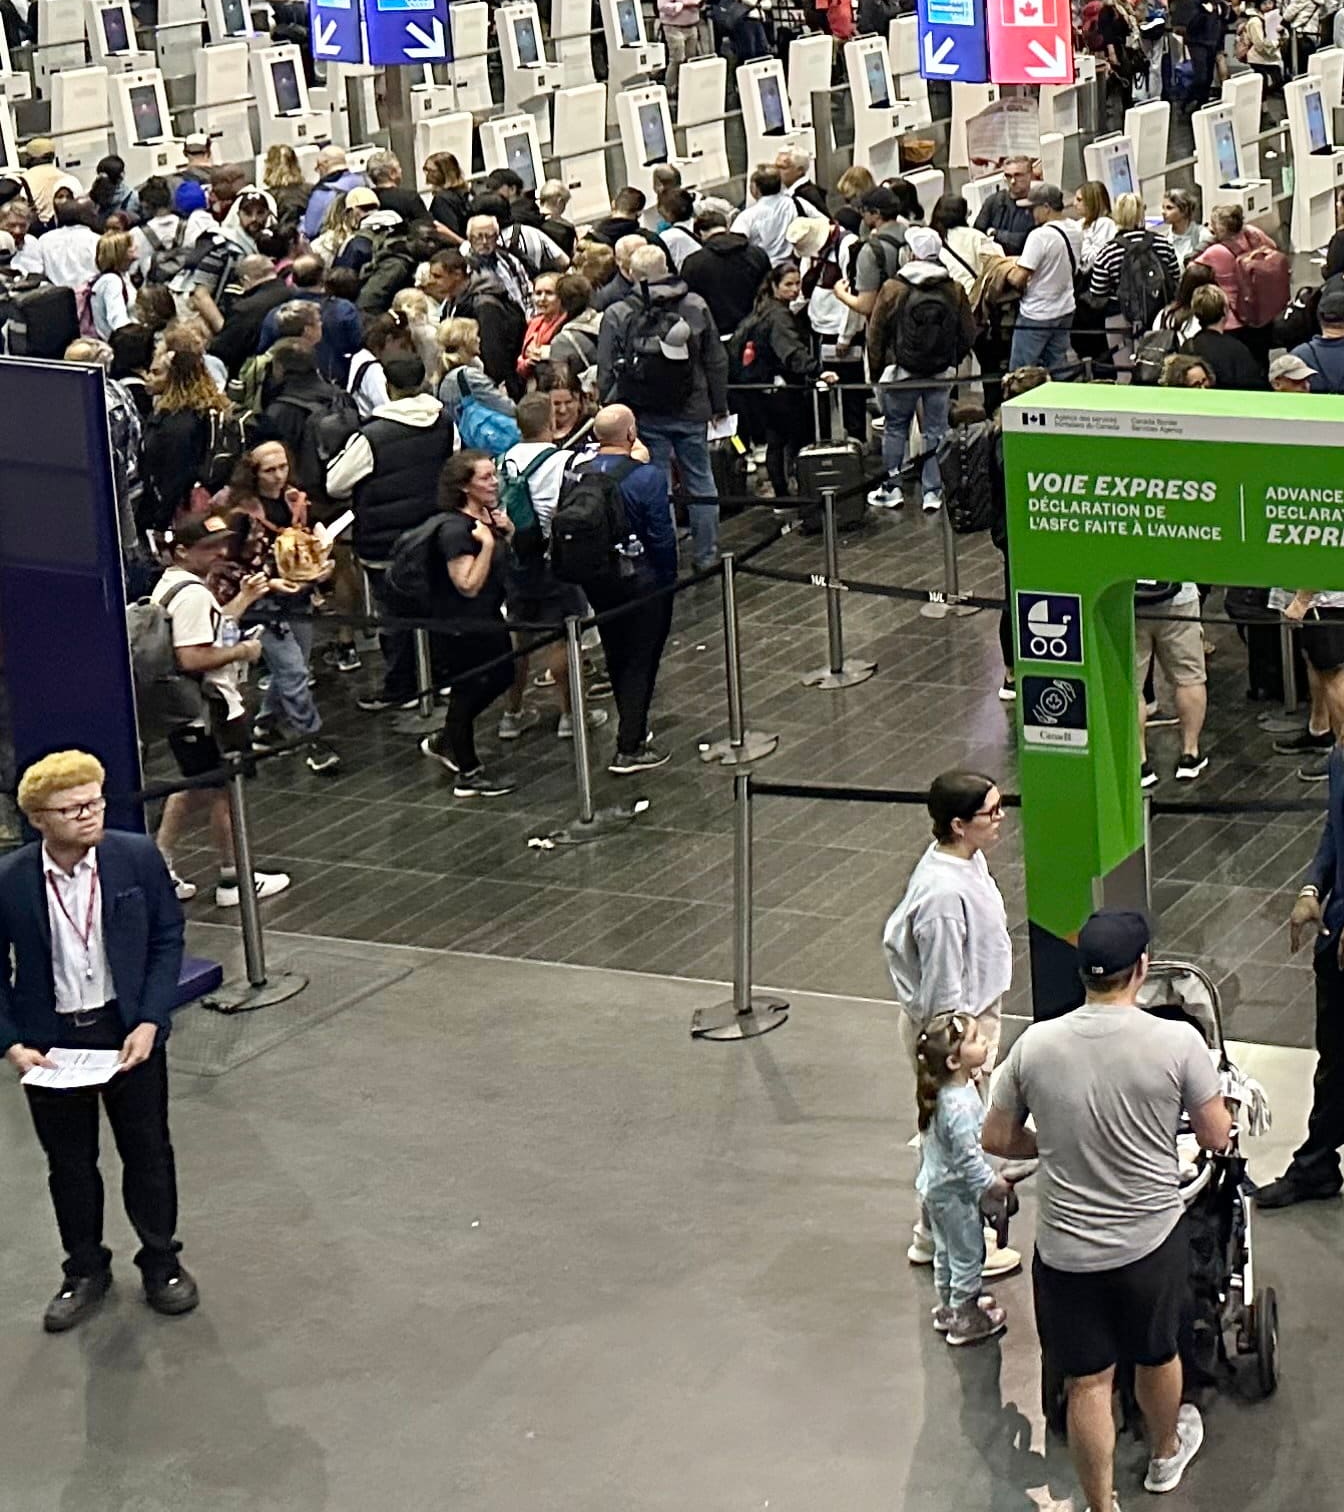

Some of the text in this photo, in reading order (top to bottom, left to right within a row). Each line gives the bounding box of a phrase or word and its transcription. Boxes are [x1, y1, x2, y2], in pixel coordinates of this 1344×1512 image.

[1027, 472, 1217, 502] VOIE EXPRESS
[1266, 486, 1344, 503] ADVANCE
[1028, 495, 1166, 519] DÉCLARATION DE
[1030, 516, 1222, 541] L'ASFC FAITE À L'AVANCE
